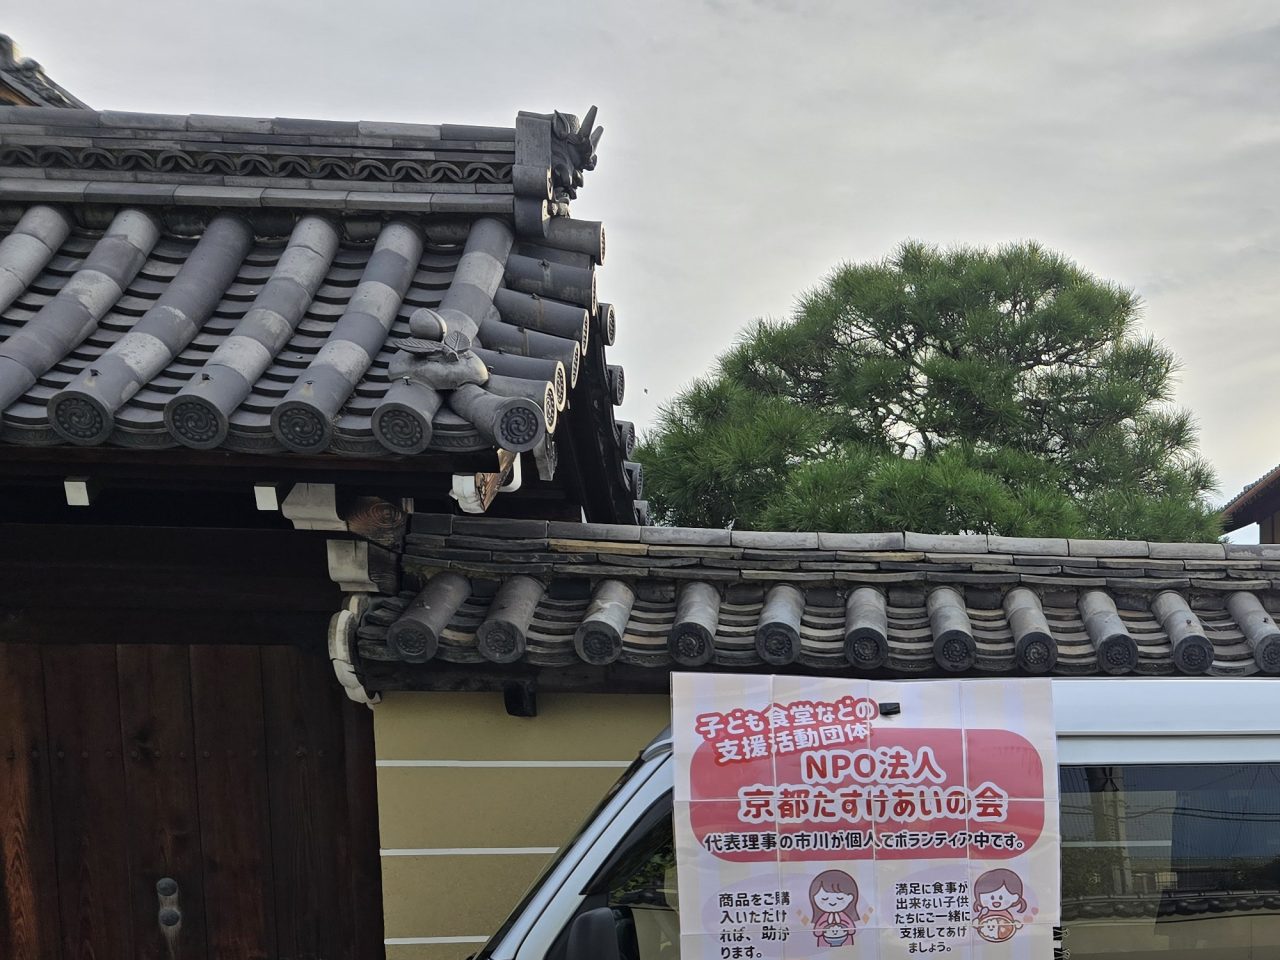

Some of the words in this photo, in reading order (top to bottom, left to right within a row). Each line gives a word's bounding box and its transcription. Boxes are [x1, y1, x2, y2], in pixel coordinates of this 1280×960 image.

[699, 699, 874, 739] 子ども食堂などの
[715, 723, 869, 763] 支援活動団体
[805, 750, 942, 781] NPO法人
[742, 785, 1004, 819] 京都たすけあいの会
[704, 831, 1025, 852] 代表理事の市川が個人でボランティア中です。
[895, 881, 969, 896] 満足に食事が
[718, 891, 791, 907] 商品をご購
[895, 896, 969, 910] 出来ない子供
[719, 908, 787, 924] 入いただけ
[894, 910, 971, 924] たちにご一緒に
[720, 946, 763, 960] ります。
[908, 942, 953, 953] ましょう。
